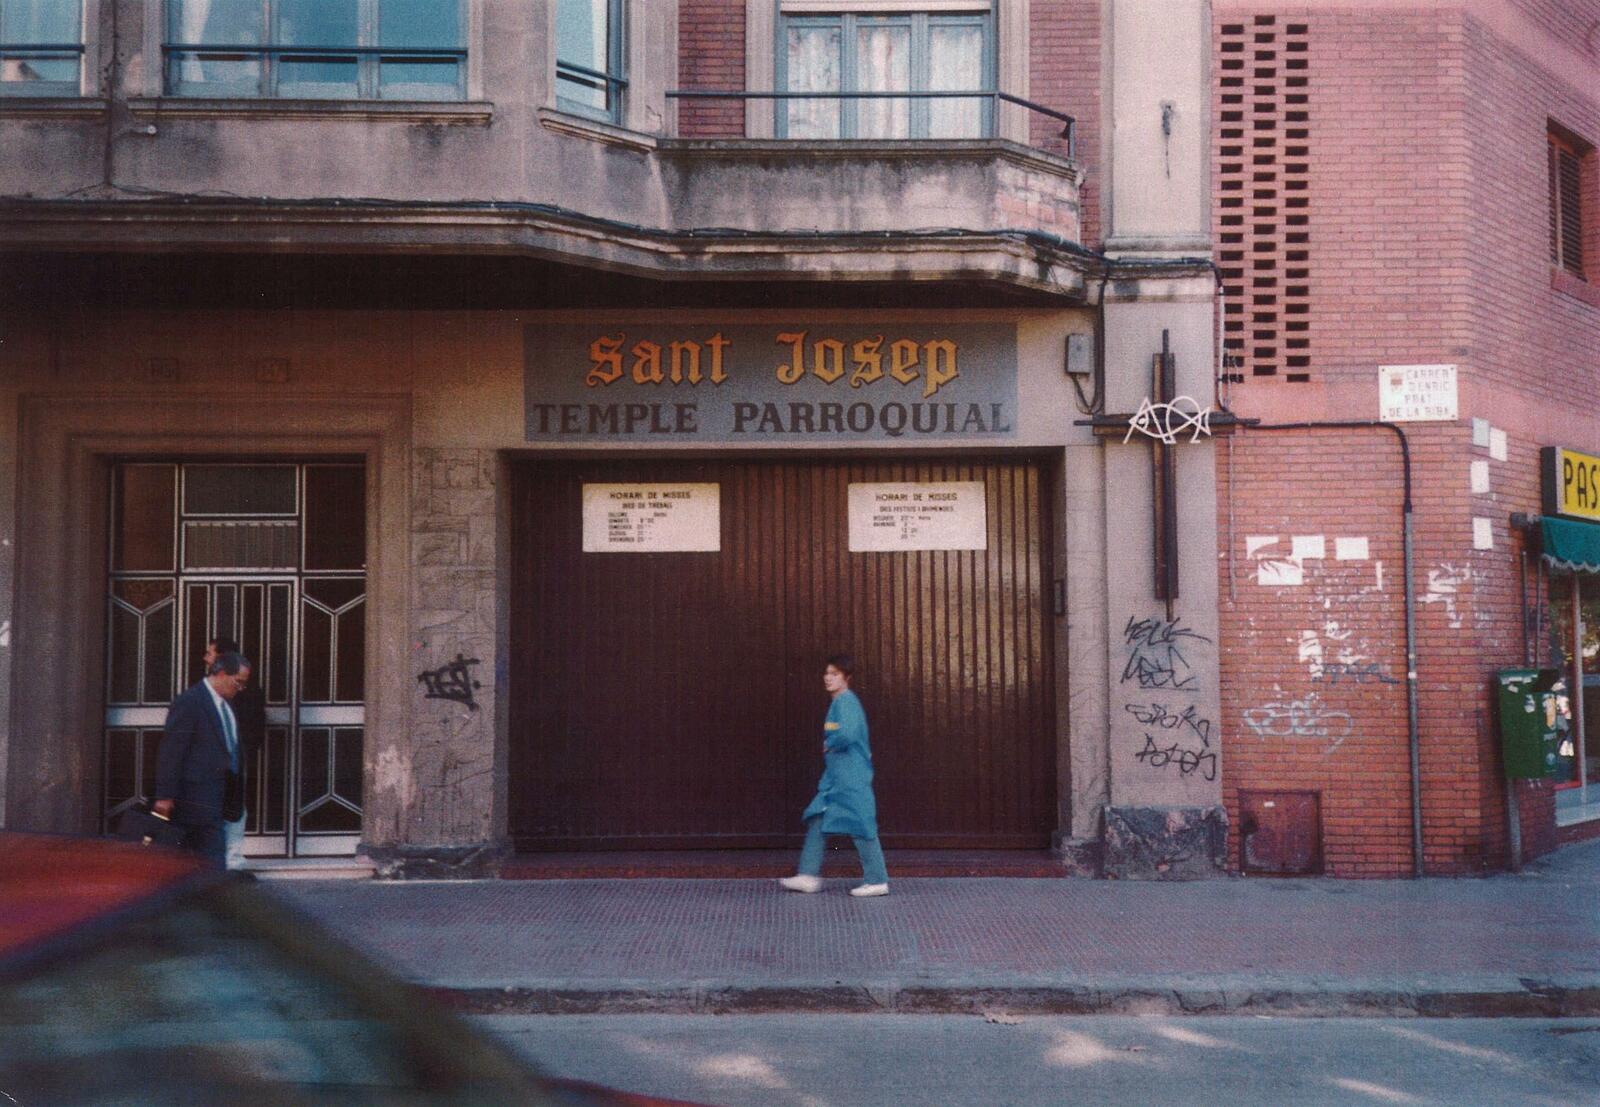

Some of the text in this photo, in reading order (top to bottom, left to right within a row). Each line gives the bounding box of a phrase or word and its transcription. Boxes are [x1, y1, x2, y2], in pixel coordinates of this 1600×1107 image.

[585, 330, 962, 398] Sant Josep
[534, 401, 1012, 436] TEMPLE PARROQUIAL
[609, 491, 691, 500] HORARI DE MISSES
[875, 492, 958, 501] HORARI DE MISSES
[1563, 457, 1600, 509] PAS
